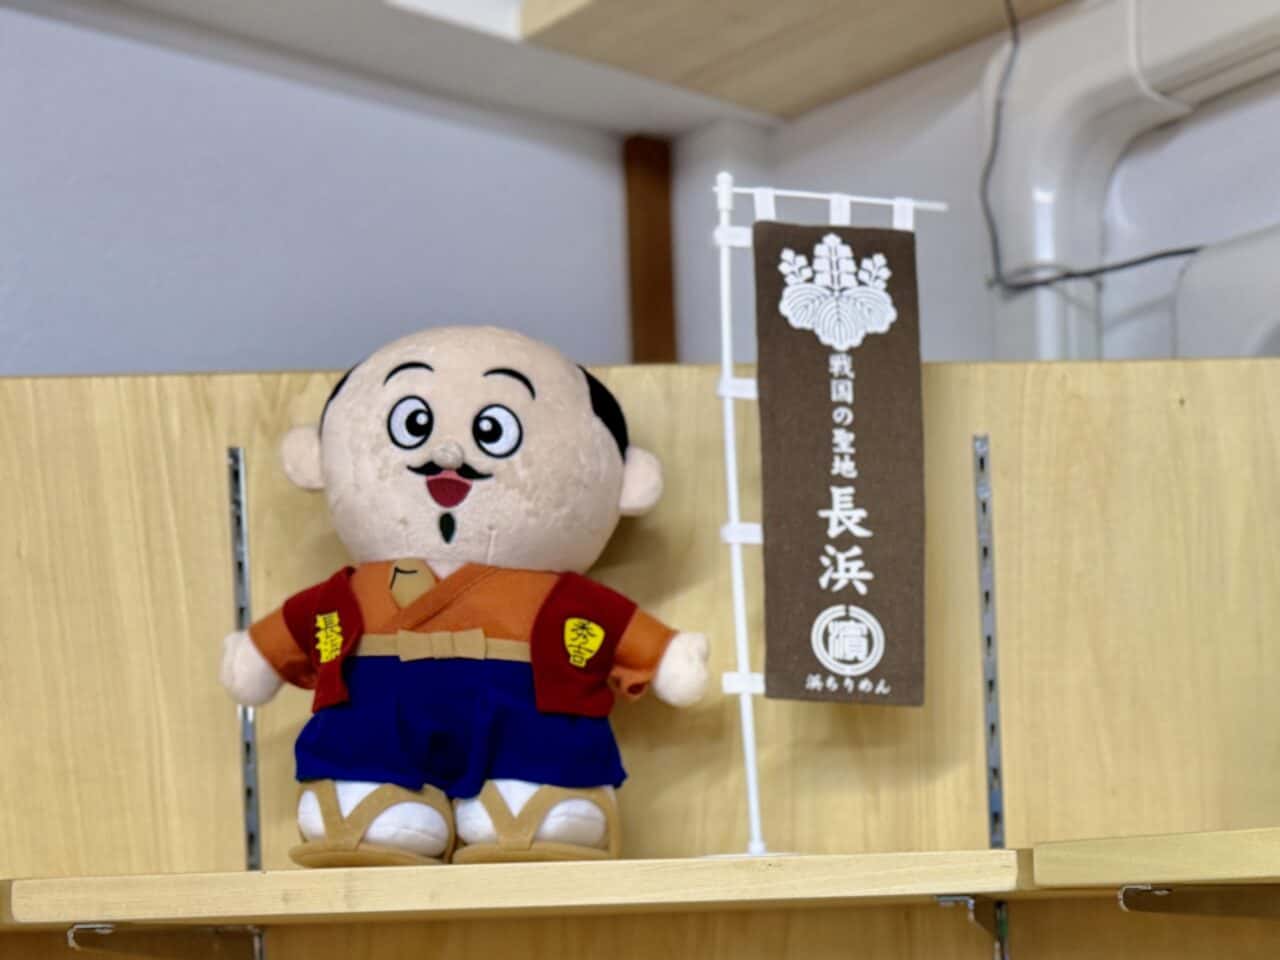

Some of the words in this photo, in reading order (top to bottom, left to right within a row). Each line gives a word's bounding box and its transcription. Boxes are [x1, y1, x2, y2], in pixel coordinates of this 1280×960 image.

[828, 352, 858, 479] 戦国の聖地
[817, 485, 874, 595] 長浜
